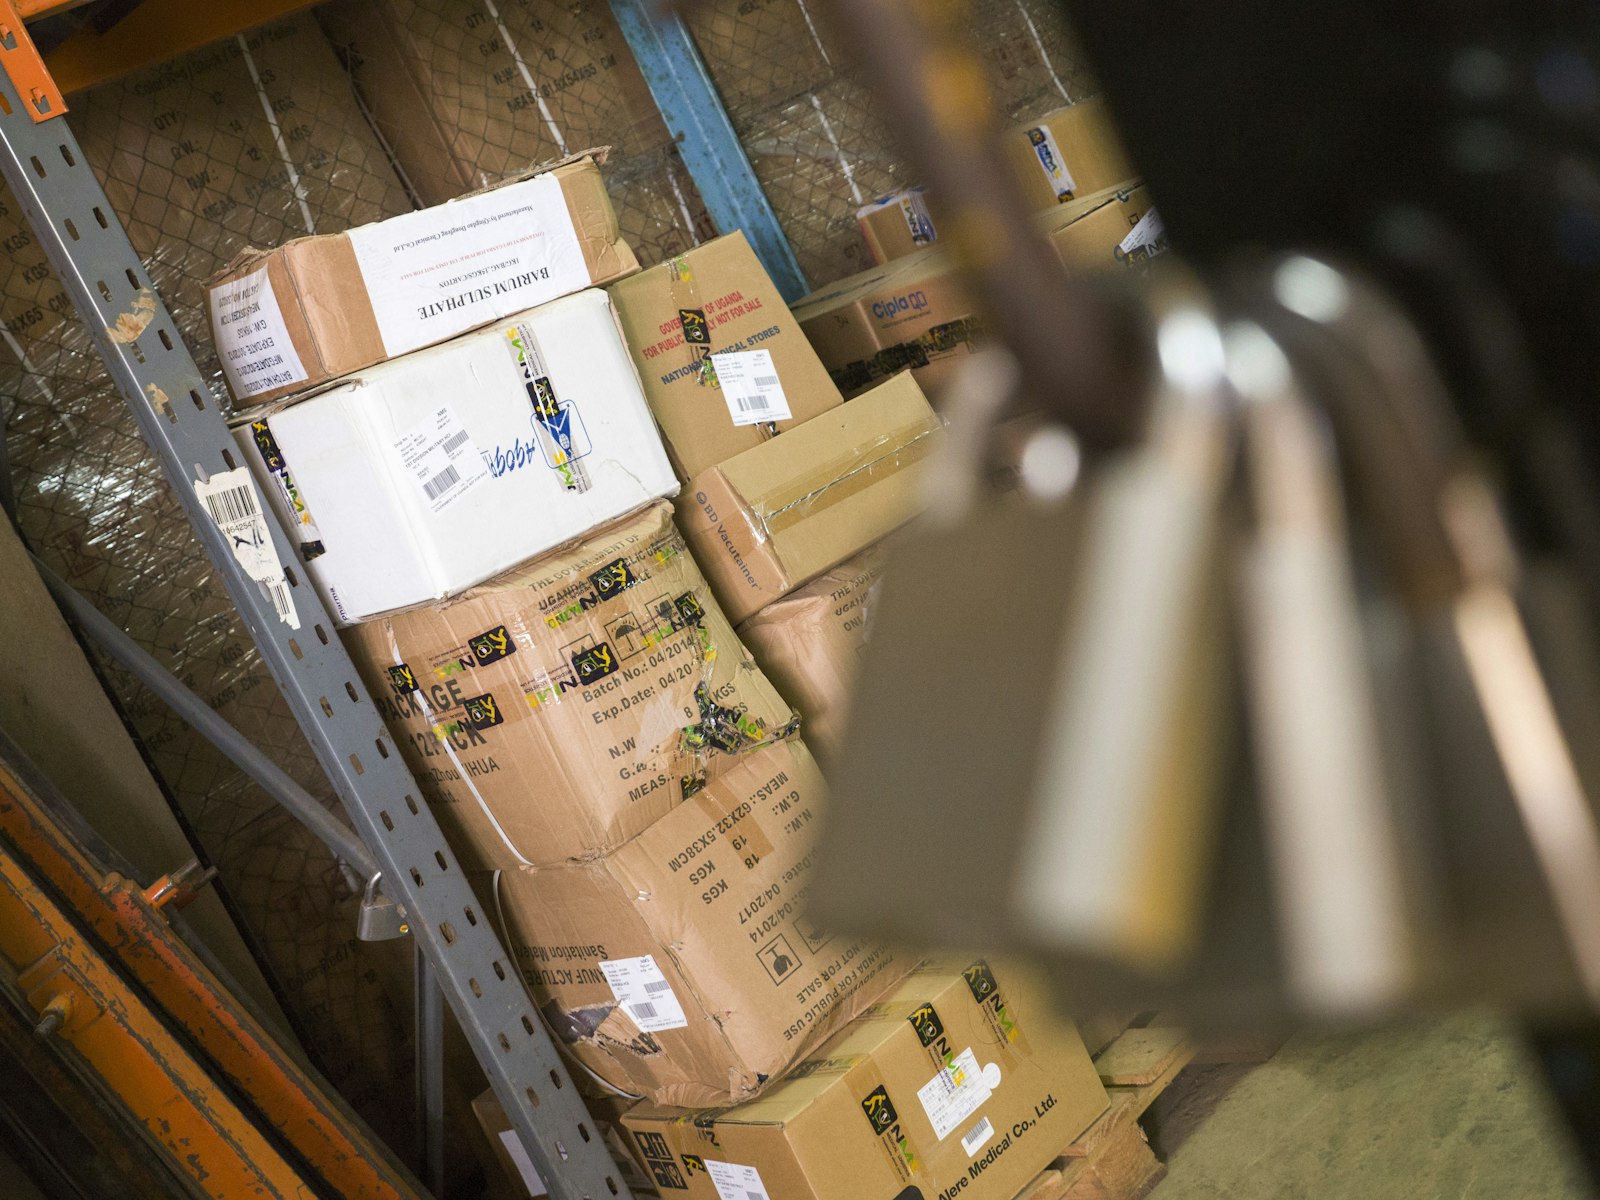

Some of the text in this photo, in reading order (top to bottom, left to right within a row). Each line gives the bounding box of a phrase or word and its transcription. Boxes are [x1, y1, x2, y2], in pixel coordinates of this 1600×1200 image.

[497, 206, 533, 220] Manufactured
[415, 233, 441, 246] Chemical
[418, 267, 549, 320] BARIUM SULPHATE
[705, 303, 715, 314] OF
[714, 290, 744, 311] UGANDA
[872, 294, 909, 322] Cipla
[642, 346, 659, 360] FOR
[658, 334, 685, 353] PUBLIC
[716, 312, 731, 325] NOT
[730, 306, 743, 319] FOR
[743, 298, 762, 314] SALE
[746, 325, 780, 346] STORES
[272, 370, 293, 383] BATCH
[704, 504, 758, 588] BD Vacutainer
[529, 574, 554, 593] THE
[830, 587, 851, 601] THE
[582, 634, 696, 703] Batch No.: 04/2014
[592, 662, 698, 724] Exp.Date: 04/20
[712, 684, 736, 702] KGS
[628, 773, 674, 802] MEAS.:
[668, 771, 789, 872] MEAS.: 62X32.5X38CM
[689, 790, 800, 885] G.W.: 19 KGS
[702, 808, 814, 904] N.W.: 18 KGS
[738, 883, 781, 924] 04/2017
[749, 902, 794, 943] 04/2014
[548, 944, 608, 962] Sanitation
[821, 960, 842, 982] FOR
[838, 970, 858, 992] FOR
[796, 978, 822, 1004] SALE
[804, 987, 840, 1022] PUBLIC
[783, 1019, 806, 1041] USE
[988, 992, 1019, 1042] NMS
[934, 1036, 968, 1086] NMS
[938, 1094, 1058, 1200] Alere Medical Co., Ltd.
